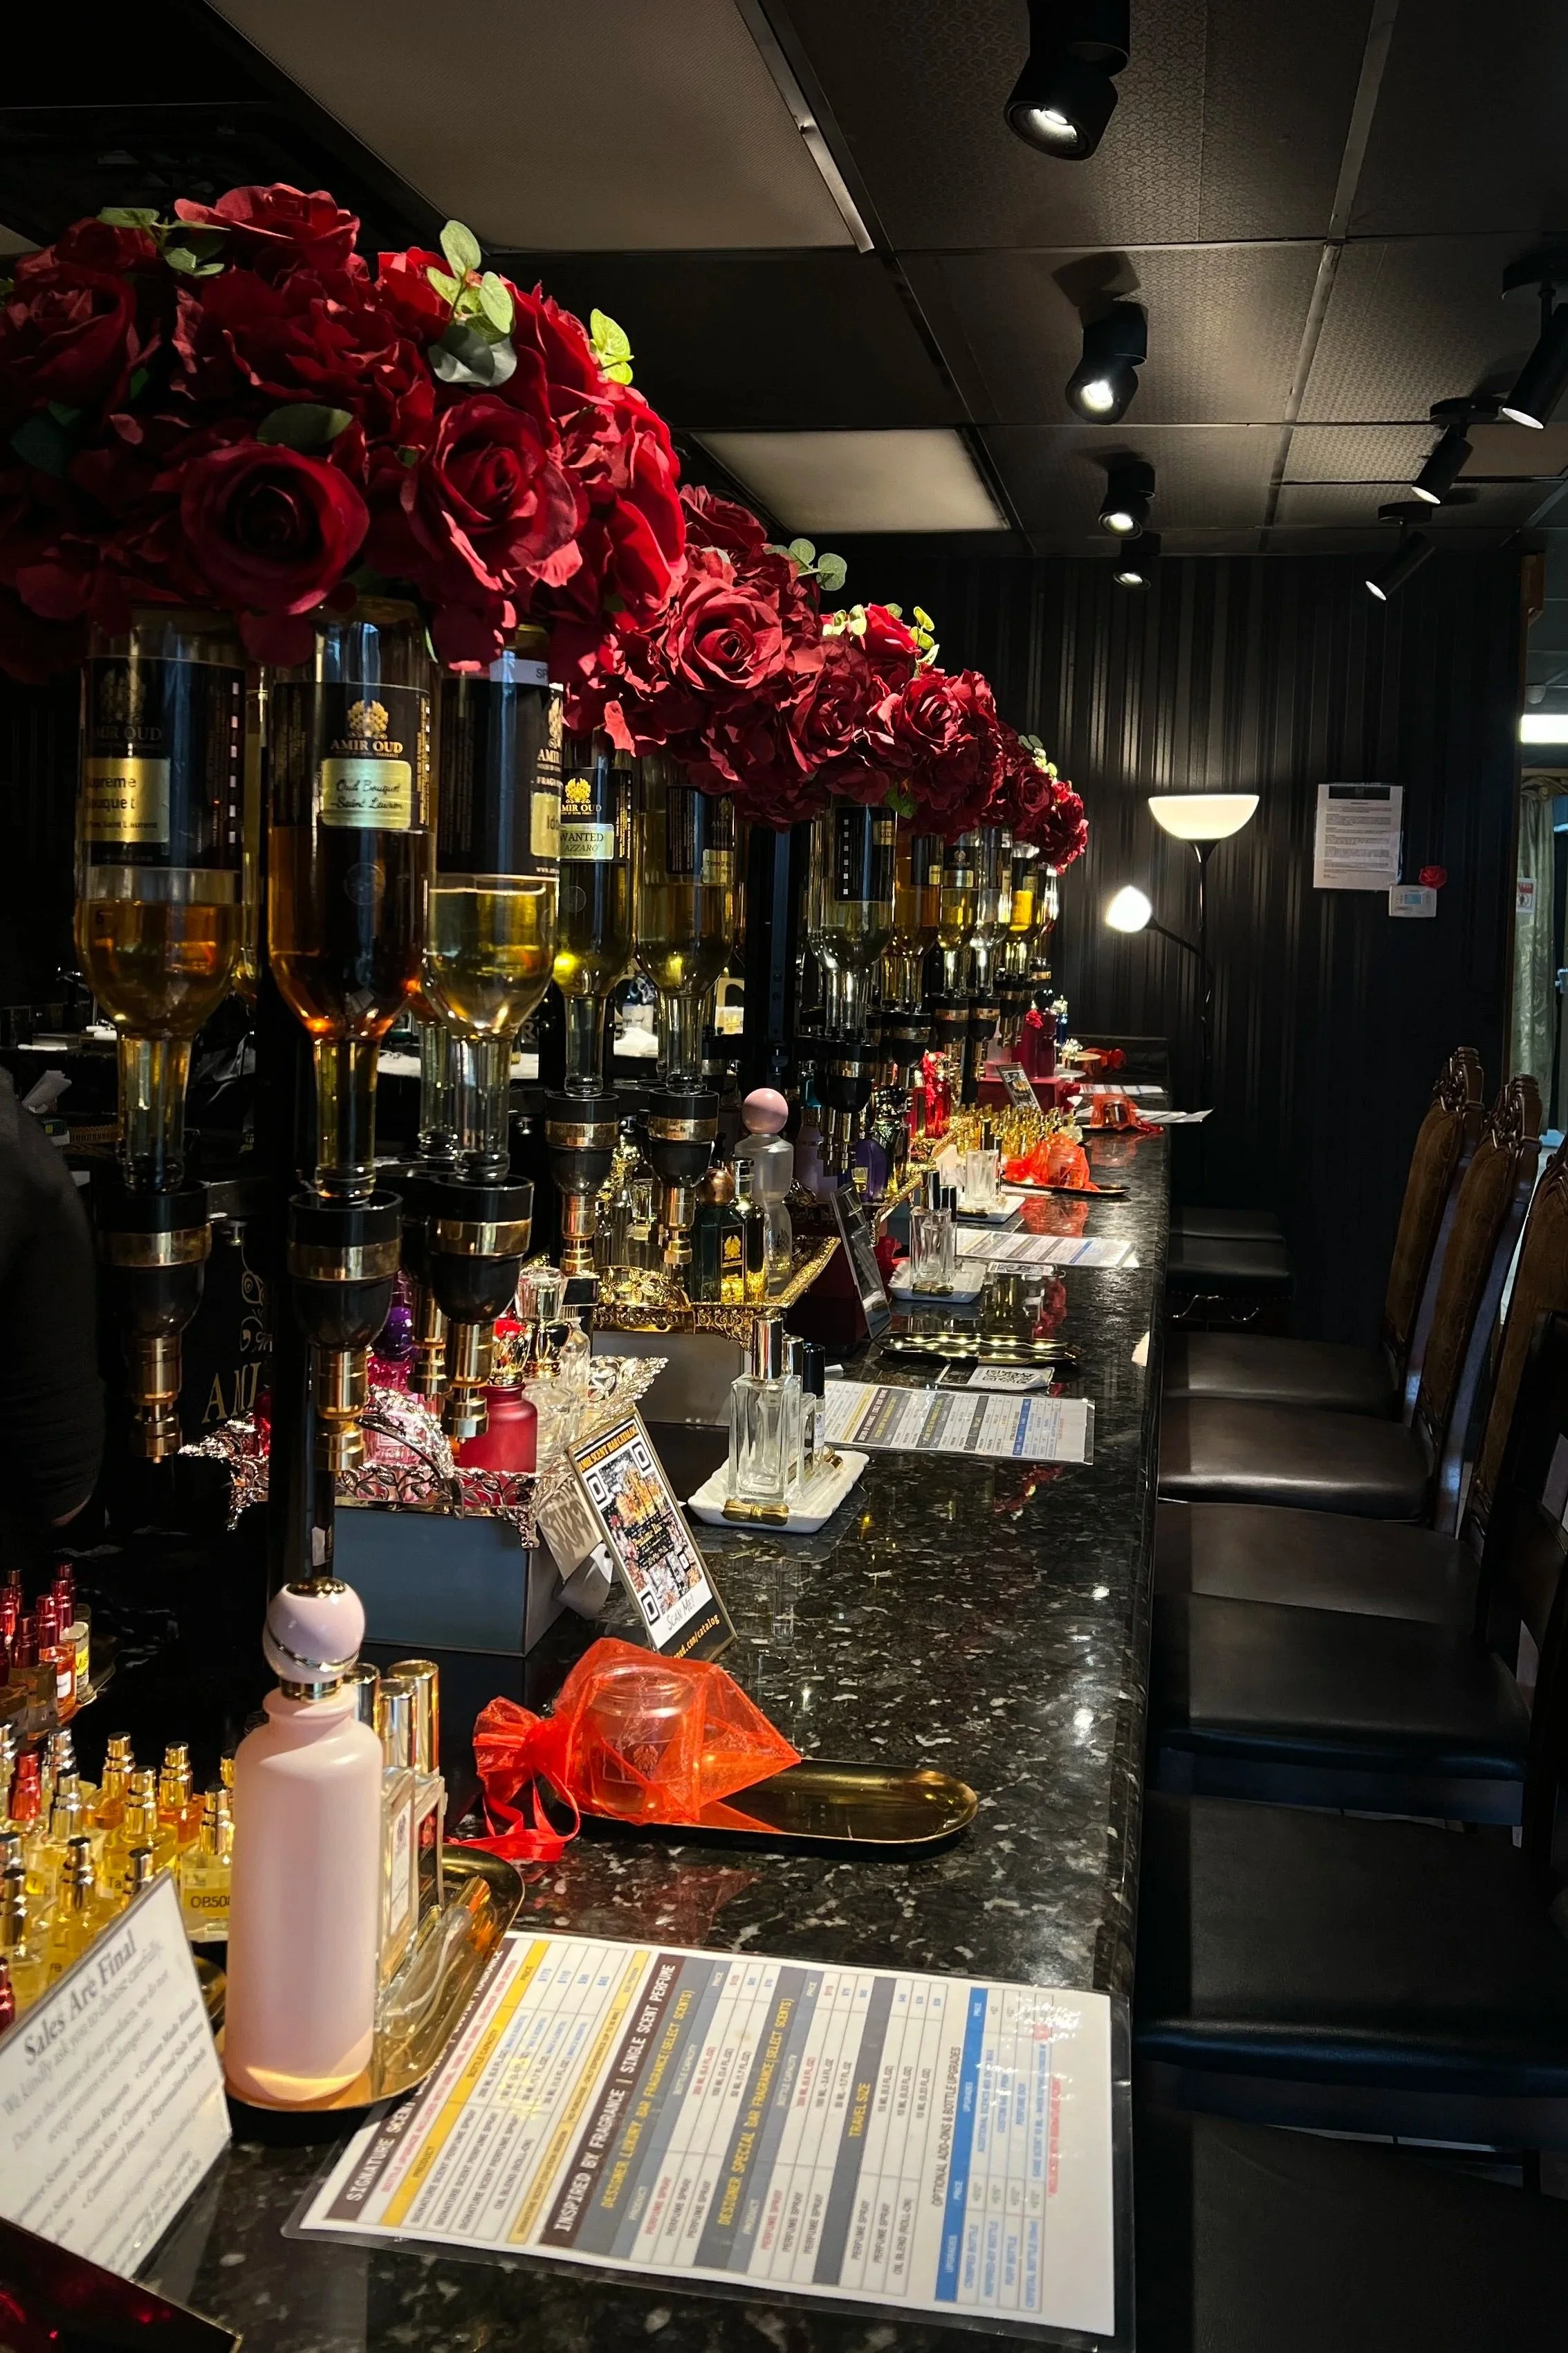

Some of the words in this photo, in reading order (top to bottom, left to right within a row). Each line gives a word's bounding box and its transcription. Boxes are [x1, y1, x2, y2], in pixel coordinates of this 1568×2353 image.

[330, 739, 368, 751] AMIR
[371, 740, 403, 754] OUD
[580, 804, 602, 812] OUD
[560, 832, 604, 842] WANTED
[564, 843, 598, 852] AZZARO
[590, 1444, 609, 1463] SCENT
[665, 1608, 683, 1630] SCAN
[672, 1614, 720, 1658] oud.com/catalog
[518, 1965, 534, 1980] PRICE
[648, 1964, 678, 2002] PERFUME
[24, 2016, 66, 2066] Sales
[69, 1977, 97, 2022] Are
[98, 1928, 137, 1987] Final
[635, 2004, 662, 2033] SCENT
[465, 2056, 485, 2077] BOTTLE
[478, 2029, 500, 2054] CAPACITY
[618, 2036, 649, 2073] SINGLE
[947, 2046, 961, 2084] UPGRADES
[598, 2159, 630, 2208] DESIGNER
[618, 2120, 645, 2158] LUXURY
[634, 2100, 653, 2118] BAR
[672, 1989, 696, 2020] SCENTS)
[855, 2082, 871, 2103] SIZE
[943, 2084, 957, 2115] BOTTLE
[587, 2088, 627, 2148] FRAGRANCE
[715, 2175, 744, 2225] DESIGNER
[730, 2131, 757, 2173] SPECIAL
[744, 2109, 763, 2128] BAR
[774, 1997, 795, 2028] SCENTS)
[848, 2103, 867, 2137] TRAVEL
[578, 2150, 602, 2169] BY
[937, 2123, 952, 2161] ADD-ONS
[342, 2136, 396, 2201] SIGNATURE
[408, 2184, 439, 2223] SIGNATURE
[430, 2162, 450, 2183] SCENT
[442, 2130, 467, 2161] PERFUME
[459, 2109, 478, 2128] SPRAY
[411, 2145, 436, 2177] PRODUCT
[432, 2187, 461, 2226] SIGNATURE
[452, 2165, 473, 2187] SCENT
[464, 2133, 489, 2163] PERFUME
[481, 2112, 500, 2132] SPRAY
[456, 2190, 485, 2231] SIGNATURE
[477, 2168, 496, 2190] SCENT
[488, 2136, 512, 2167] PERFUME
[498, 2173, 519, 2197] BLEND
[551, 2172, 593, 2231] INSPIRED
[768, 2189, 784, 2213] SPRAY
[930, 2161, 948, 2207] OPTIONAL
[952, 2179, 963, 2200] PRICE
[643, 2199, 665, 2235] PERFUME
[656, 2175, 673, 2199] SPRAY
[664, 2201, 685, 2236] PERFUME
[676, 2177, 692, 2200] SPRAY
[685, 2204, 705, 2239] PERFUME
[697, 2179, 713, 2203] SPRAY
[789, 2191, 804, 2215] SPRAY
[810, 2193, 825, 2217] SPRAY
[857, 2200, 871, 2224] SPRAY
[878, 2203, 892, 2226] SPRAY
[898, 2197, 914, 2235] (ROLL-ON)
[759, 2214, 778, 2250] PERFUME
[780, 2216, 799, 2252] PERFUME
[802, 2218, 820, 2254] PERFUME
[851, 2224, 867, 2260] PERFUME
[872, 2227, 887, 2263] PERFUME
[894, 2236, 909, 2261] BLEND
[892, 2261, 905, 2275] OIL
